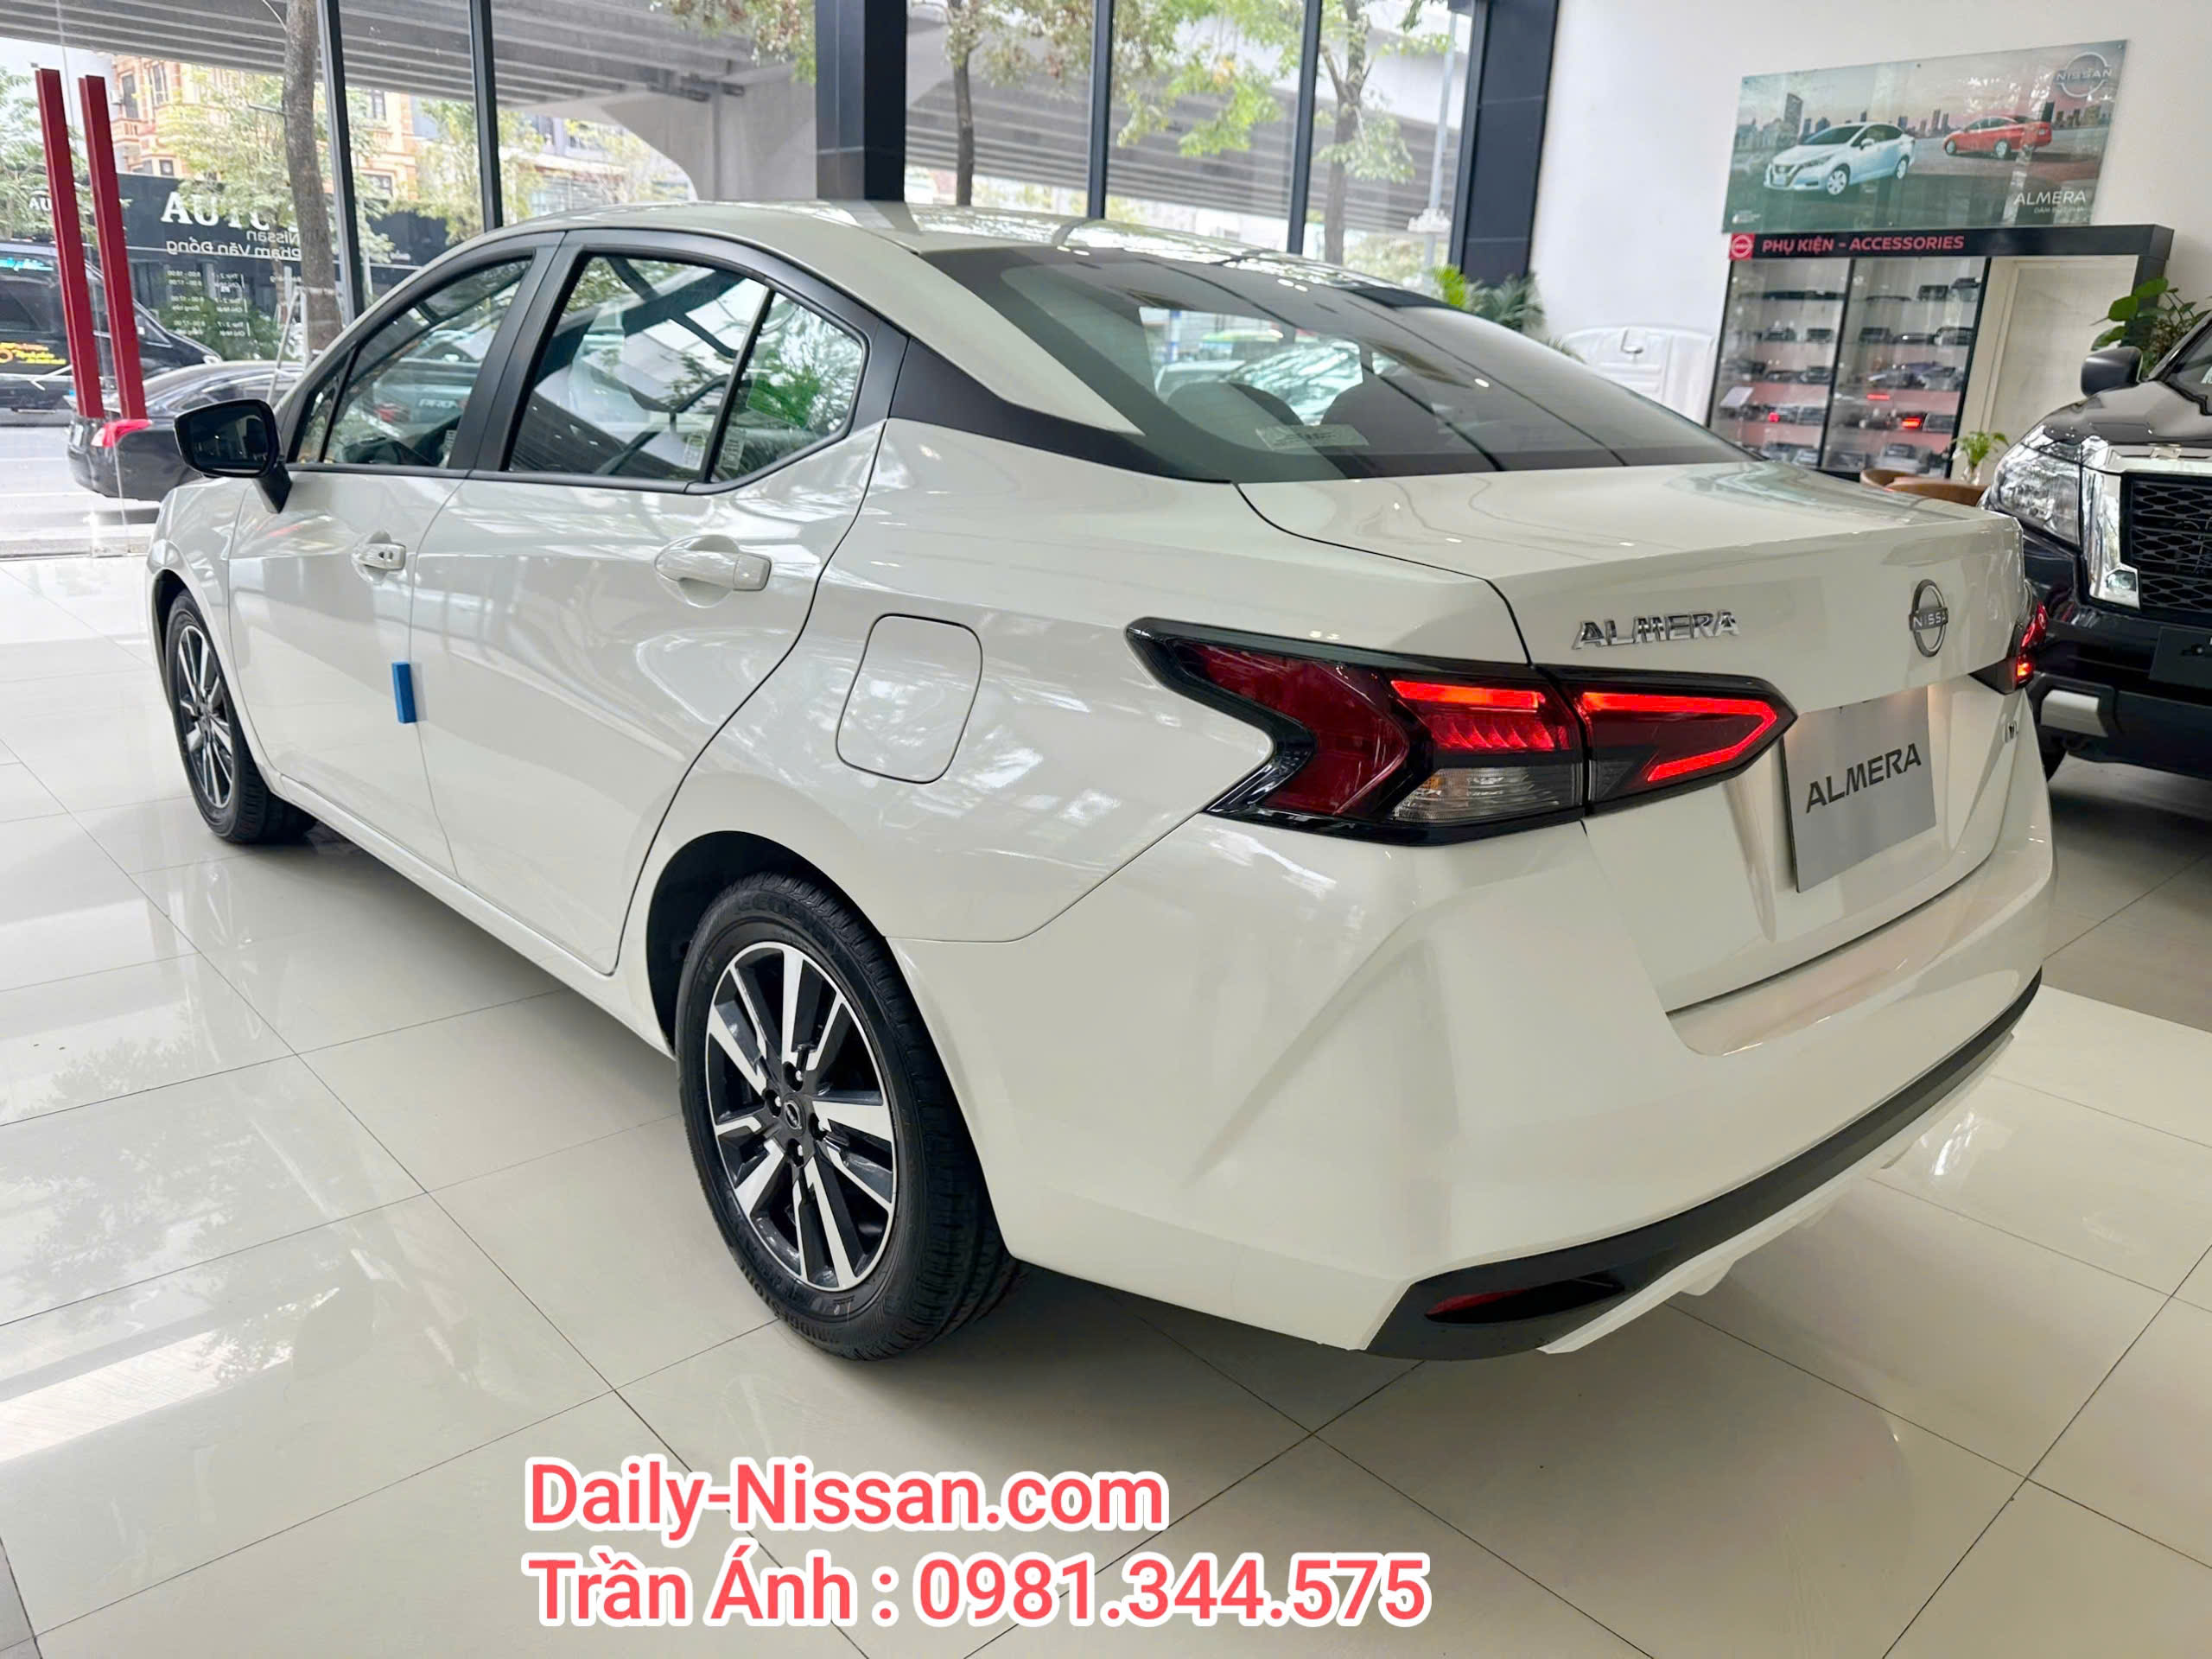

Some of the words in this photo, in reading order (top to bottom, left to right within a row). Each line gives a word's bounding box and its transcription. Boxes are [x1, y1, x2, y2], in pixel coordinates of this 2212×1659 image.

[2056, 69, 2112, 81] NISSAN
[2013, 189, 2086, 206] ALMERA
[1762, 239, 1795, 255] PHỤ
[1797, 235, 1834, 254] KIỆN
[1849, 235, 1964, 251] ACCESSORIES
[1571, 610, 1740, 651] ALMERA
[1806, 743, 1923, 813] ALMERA
